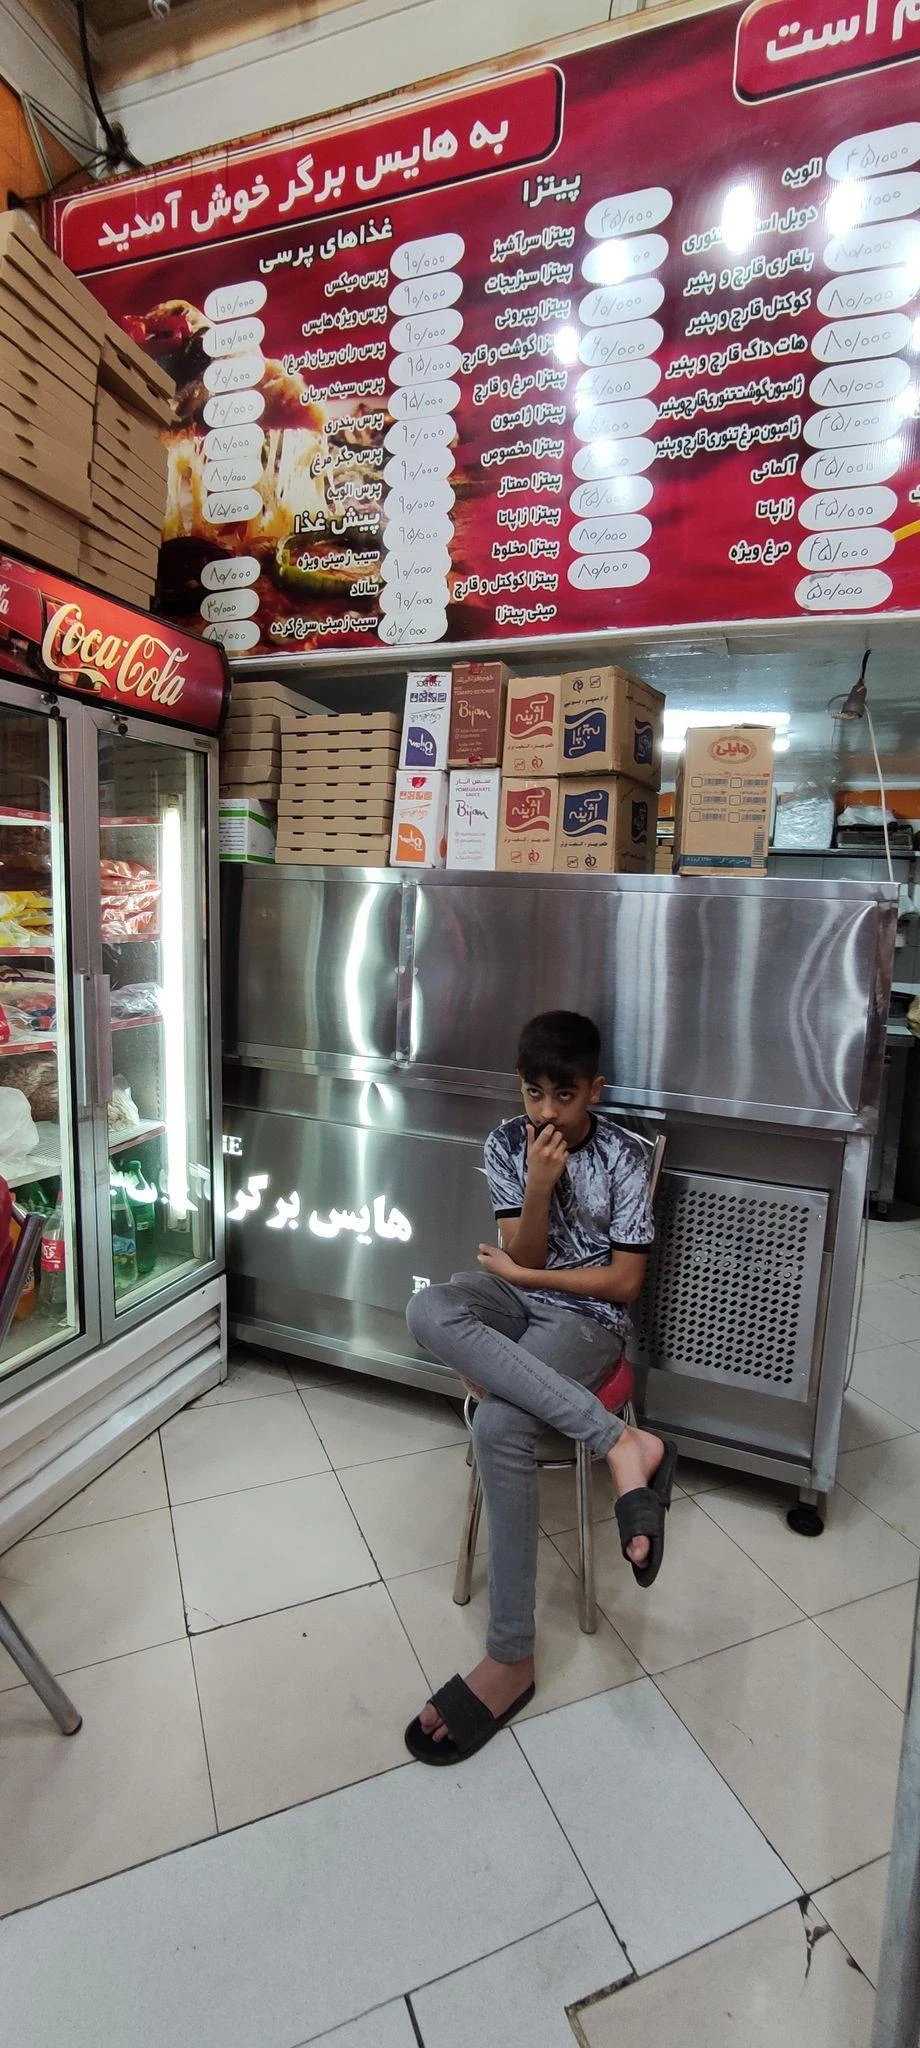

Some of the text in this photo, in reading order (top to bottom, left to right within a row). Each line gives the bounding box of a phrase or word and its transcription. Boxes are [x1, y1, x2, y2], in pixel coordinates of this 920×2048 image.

[767, 0, 877, 61] است
[97, 117, 509, 251] به هایس برگر خوش آمدید
[782, 158, 823, 188] الویه
[522, 173, 582, 208] پیتزا
[779, 206, 817, 230] دوبل
[259, 217, 392, 273] غذاهای پرسی
[490, 226, 575, 262] پیتزا سرآشپز
[325, 269, 388, 297] پرس میکس
[485, 262, 573, 294] پیتزا سبزیجات
[684, 248, 813, 297] بلغاری قارچ و پنیر
[303, 305, 387, 335] پرس ویژه هایس
[495, 298, 571, 329] پیتزا پپرونی
[686, 290, 811, 335] کوکتل قارچ و پنیر
[338, 347, 357, 365] ران
[359, 342, 385, 360] پرس
[461, 346, 487, 372] قارچ
[489, 350, 498, 363] و
[499, 337, 536, 361] گوشت
[666, 335, 807, 377] هات داگ قارچ و پنیر
[301, 377, 384, 404] پرس سینه بریان
[474, 368, 567, 404] پیتزا مرغ و قارچ
[324, 412, 384, 434] پرس بندری
[491, 403, 564, 432] پیتزا ژامبون
[311, 448, 383, 474] پرس جگر مرغ
[482, 438, 563, 466] پیتزا مخصوص
[751, 455, 798, 483] آلمانی
[328, 482, 382, 502] پرس الویه
[498, 472, 563, 496] پیتزا ممتاز
[294, 506, 380, 534] پیش غذا
[497, 507, 561, 530] پیتزا زاپاتا
[756, 497, 795, 523] زاپاتا
[297, 550, 379, 571] سیب زمینی ویژه
[492, 540, 559, 560] پیتزا مخلوط
[729, 540, 791, 565] مرغ ویژه
[350, 580, 378, 596] سالاد
[454, 571, 558, 598] پیتزا کوکتل و قارچ
[496, 602, 556, 625] مینی پیتزا
[271, 616, 378, 639] سیب زمینی سرخ کرده
[457, 700, 491, 725] Bijan
[408, 733, 434, 756] Bijan
[456, 800, 489, 826] Bijan
[227, 1174, 413, 1245] هایس برگر
